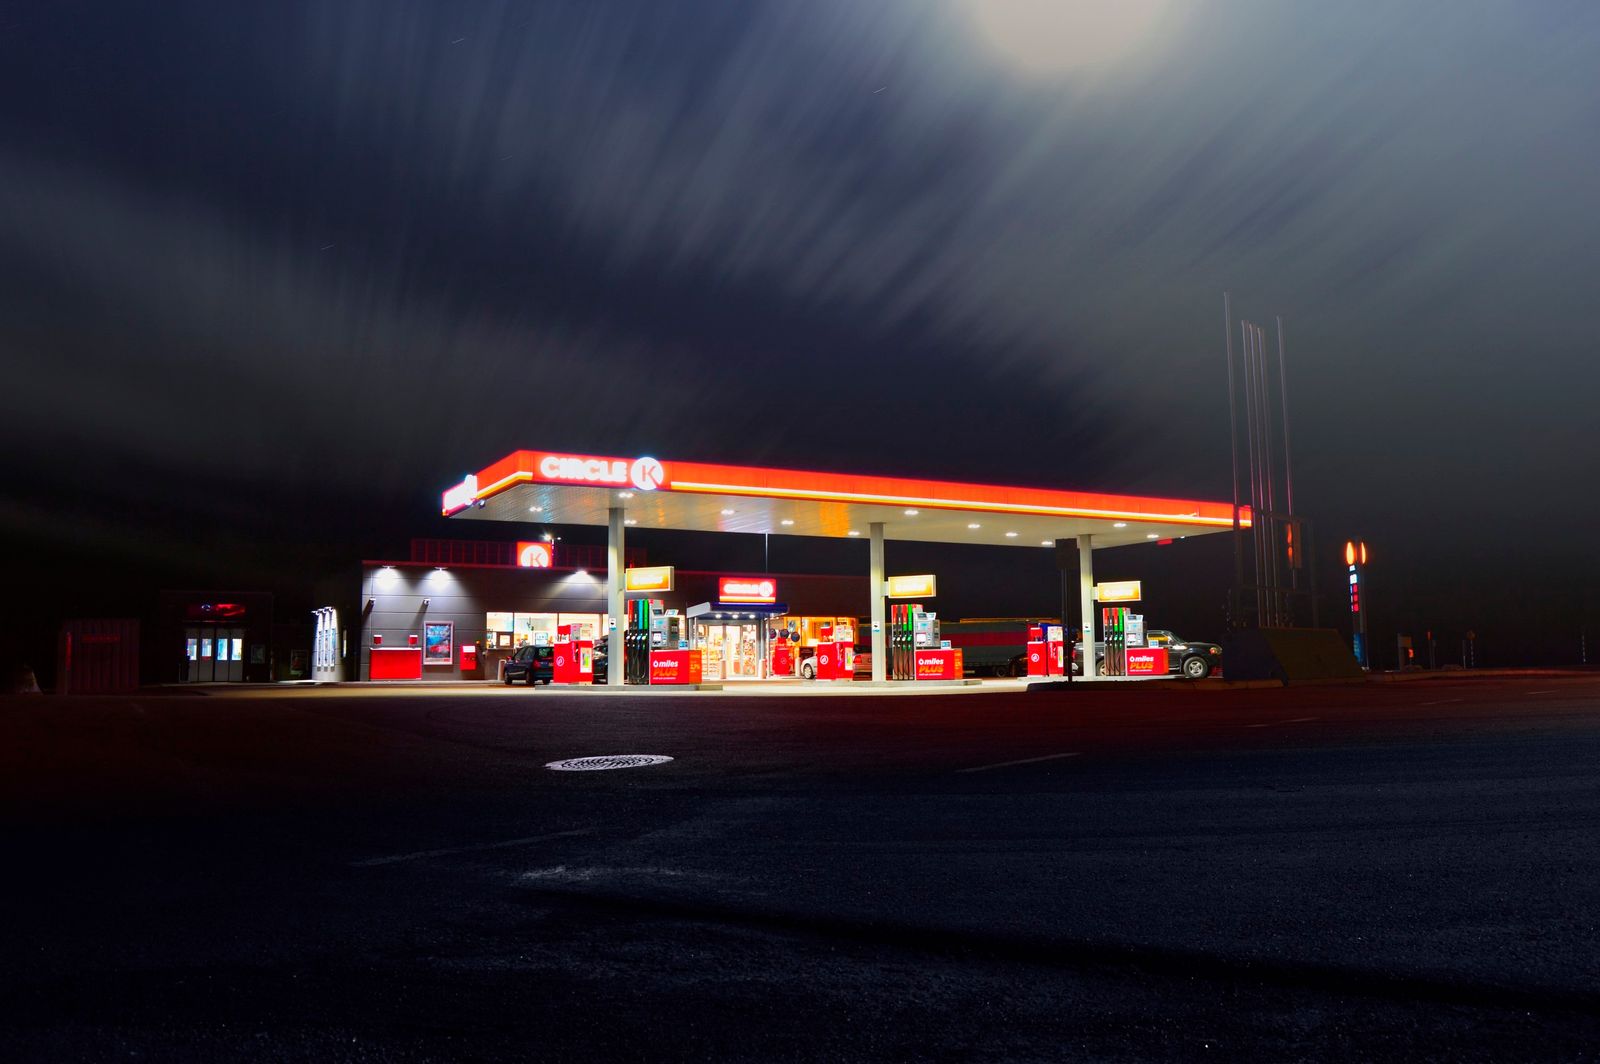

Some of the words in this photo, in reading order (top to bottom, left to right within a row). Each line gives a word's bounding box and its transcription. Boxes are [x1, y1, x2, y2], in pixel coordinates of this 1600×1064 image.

[541, 456, 627, 482] CIRCLE
[640, 463, 662, 489] K
[653, 667, 678, 676] PLUS
[919, 665, 944, 673] PLUS
